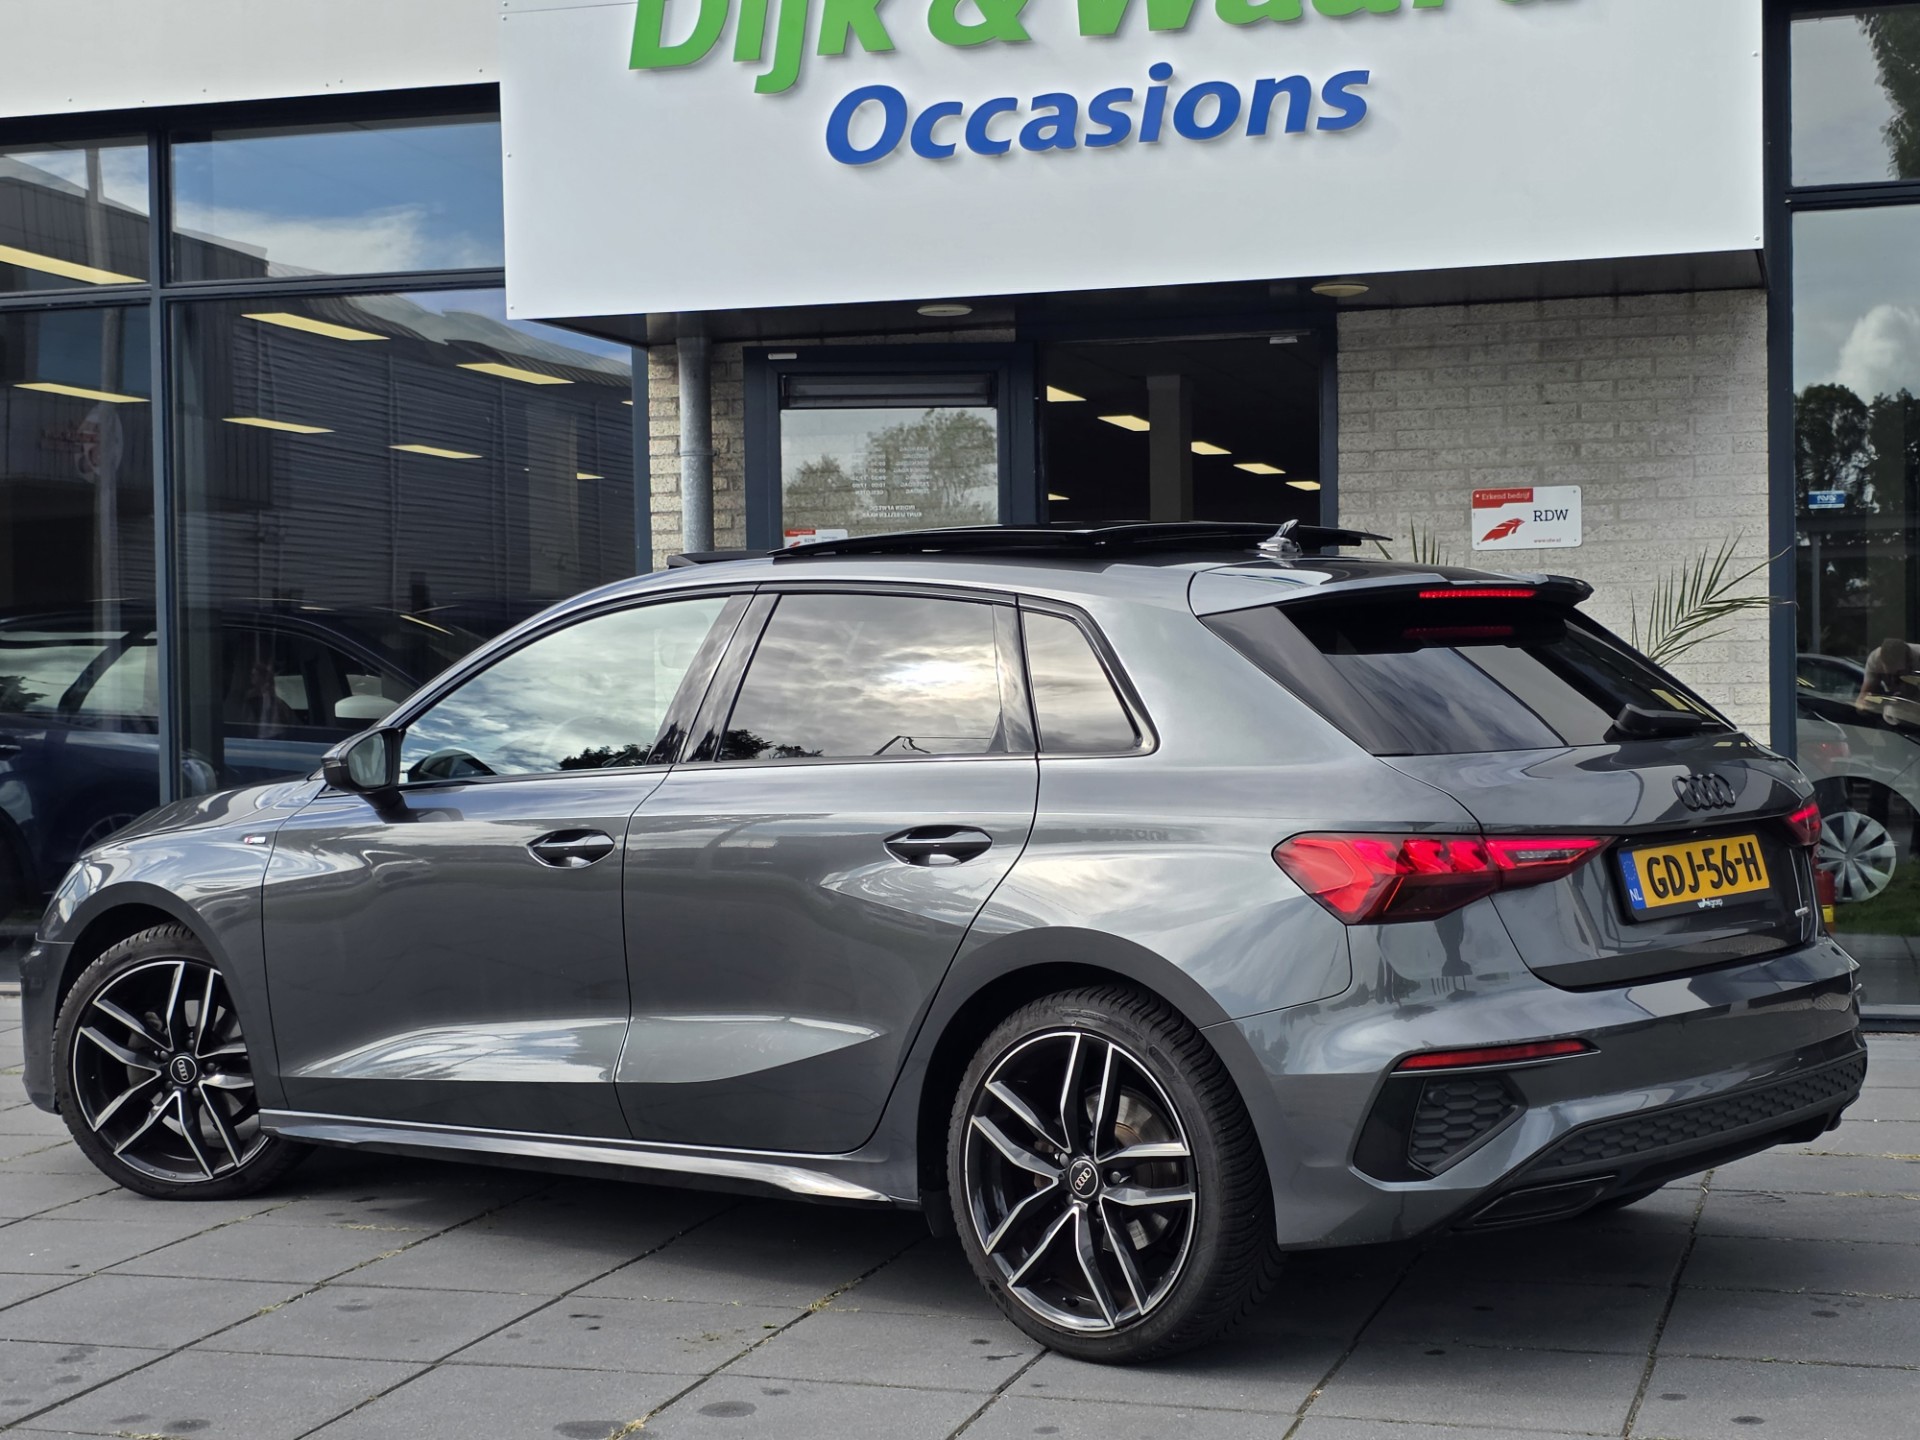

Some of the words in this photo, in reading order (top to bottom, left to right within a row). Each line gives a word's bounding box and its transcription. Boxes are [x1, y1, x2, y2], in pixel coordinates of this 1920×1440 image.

[826, 62, 1370, 165] Occasions
[1533, 509, 1569, 522] RDW
[1647, 842, 1763, 899] GDJ-56-H
[1629, 888, 1643, 902] NL
